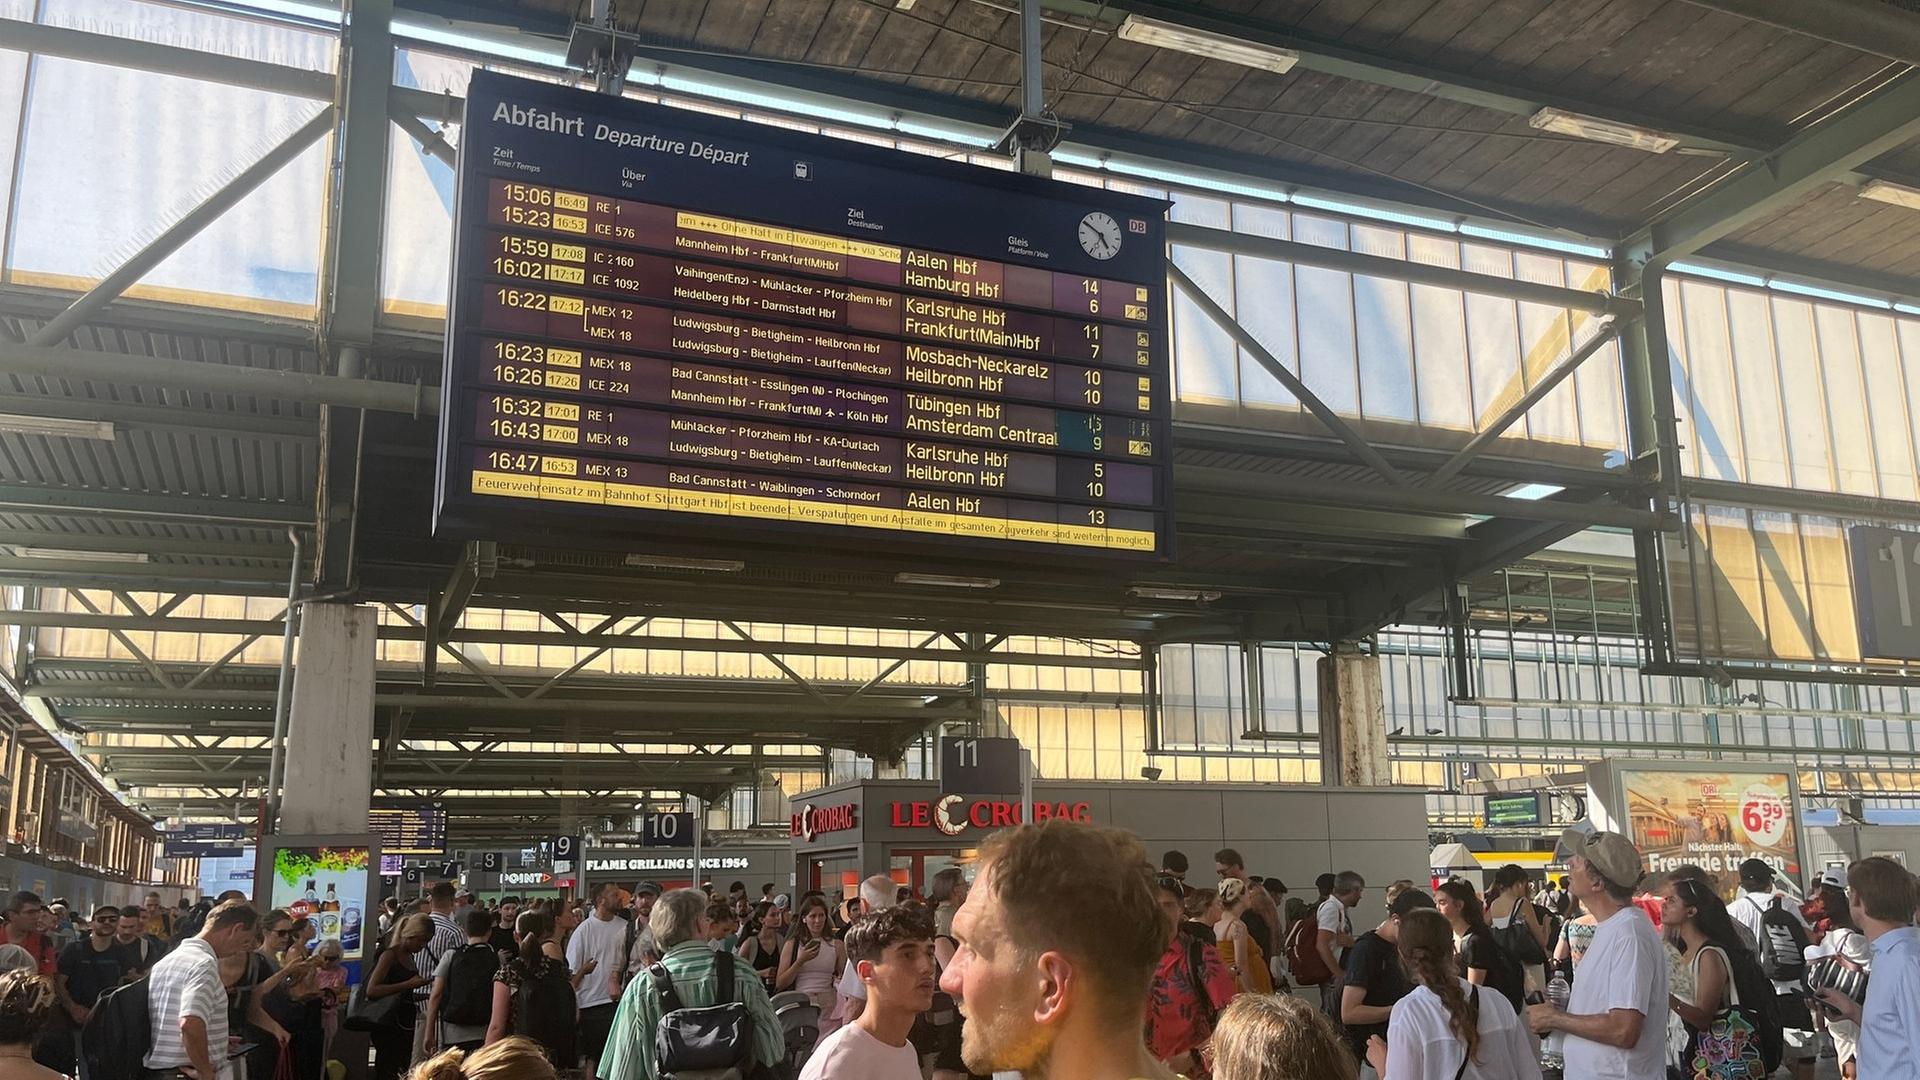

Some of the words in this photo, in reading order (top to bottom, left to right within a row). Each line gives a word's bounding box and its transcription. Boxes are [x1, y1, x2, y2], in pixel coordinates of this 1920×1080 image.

[493, 102, 584, 137] Abfahrt
[594, 124, 685, 155] Departure
[689, 141, 749, 167] Départ
[493, 146, 514, 159] Zeit
[621, 167, 646, 182] Über
[621, 180, 633, 189] Via
[847, 208, 864, 220] Ziel
[847, 219, 884, 232] Destination
[1129, 219, 1146, 233] DB
[503, 184, 551, 206] 15:06
[557, 195, 587, 210] 16:49
[596, 202, 610, 214] RE
[614, 206, 621, 215] 1
[721, 222, 748, 235] Ohne
[751, 227, 772, 238] Halt
[774, 232, 784, 241] in
[786, 232, 838, 250] Ellwangen
[861, 247, 876, 256] via
[906, 250, 948, 271] Aalen
[953, 258, 978, 276] Hbf
[1082, 280, 1099, 295] 14
[1007, 236, 1029, 248] Gleis
[502, 206, 551, 228] 15:23
[556, 216, 585, 231] 16:53
[595, 224, 612, 236] ICE
[615, 227, 636, 239] 576
[675, 236, 729, 254] Mannheim
[731, 245, 750, 257] Hbf
[905, 270, 970, 297] Hamburg
[975, 281, 999, 299] Hbf
[1090, 300, 1099, 314] 6
[500, 236, 549, 258] 15:59
[555, 247, 584, 260] 17:08
[593, 252, 605, 264] IC
[607, 254, 635, 268] 2160
[675, 265, 750, 286] Vaihingen(Enz)
[823, 288, 874, 305] Pforzheim
[876, 296, 893, 307] Hbf
[906, 298, 977, 322] Karlsruhe
[982, 309, 1006, 327] Hbf
[1083, 324, 1099, 340] 11
[493, 258, 542, 280] 16:02
[554, 268, 583, 282] 17:17
[592, 274, 610, 286] ICE
[613, 278, 640, 291] 1092
[673, 286, 729, 306] Heidelberg
[731, 295, 750, 307] Hbf
[761, 300, 816, 317] Darmstadt
[818, 308, 837, 320] Hbf
[905, 318, 1041, 351] Frankfurt(Main)Hbf
[1091, 344, 1100, 359] 7
[497, 289, 546, 311] 16:22
[552, 299, 582, 313] 17:12
[591, 305, 616, 318] MEX
[620, 309, 633, 320] 12
[673, 316, 740, 338] Ludwigsburg
[751, 327, 804, 344] Bietigheim
[815, 336, 861, 352] Heilbronn
[863, 343, 881, 354] Hbf
[906, 345, 1049, 379] Mosbach-Neckarelz
[1084, 370, 1101, 386] 10
[590, 326, 615, 339] MEX
[619, 331, 633, 342] 18
[672, 337, 740, 358] Ludwigsburg
[750, 348, 804, 364] Bietigheim
[814, 356, 892, 376] Lauffen(Neckar)
[905, 366, 974, 389] Heilbronn
[979, 375, 1003, 392] Hbf
[1084, 389, 1101, 405] 10
[495, 342, 544, 363] 16:23
[550, 352, 579, 366] 17:21
[589, 357, 614, 370] MEX
[618, 361, 632, 372] 18
[672, 367, 692, 379] Bad
[695, 370, 749, 387] Cannstatt
[760, 378, 809, 396] Esslingen
[812, 385, 825, 396] (N)
[835, 388, 889, 405] Plochingen
[906, 394, 971, 418] Tübingen
[976, 402, 1001, 420] Hbf
[493, 364, 543, 386] 16:26
[548, 374, 578, 387] 17:26
[588, 379, 606, 391] ICE
[609, 382, 630, 394] 224
[671, 389, 725, 406] Mannheim
[728, 396, 747, 408] Hbf
[758, 399, 822, 417] Frankfurt(M)
[847, 410, 869, 422] Köln
[871, 413, 889, 424] Hbf
[905, 414, 994, 439] Amsterdam
[998, 425, 1059, 446] Centraal
[1093, 436, 1102, 451] 9
[492, 396, 542, 418] 16:32
[549, 405, 577, 419] 17:01
[587, 410, 602, 422] RE
[607, 412, 613, 423] 1
[670, 419, 727, 435] Mühlacker
[738, 427, 792, 442] Pforzheim
[794, 433, 812, 444] Hbf
[823, 436, 880, 452] KA-Durlach
[906, 443, 979, 467] Karlsruhe
[984, 452, 1009, 470] Hbf
[1094, 463, 1104, 478] 5
[490, 419, 541, 440] 16:43
[546, 428, 576, 441] 17:00
[586, 432, 612, 445] MEX
[615, 435, 629, 447] 18
[670, 441, 738, 460] Ludwigsburg
[749, 448, 803, 464] Bietigheim
[814, 455, 892, 474] Lauffen(Neckar)
[906, 463, 976, 486] Heilbronn
[980, 471, 1005, 488] Hbf
[1086, 482, 1104, 498] 10
[488, 451, 539, 473] 16:47
[545, 460, 575, 473] 16:53
[585, 463, 611, 476] MEX
[615, 467, 628, 479] 13
[669, 472, 690, 485] Bad
[692, 474, 747, 489] Cannstatt
[758, 481, 815, 497] Waiblingen
[826, 487, 881, 502] Schorndorf
[907, 492, 950, 511] Aalen
[955, 497, 981, 515] Hbf
[1088, 509, 1105, 525] 13
[478, 476, 583, 497] Feuerwehreinsatz
[587, 488, 601, 498] im
[605, 488, 650, 502] Bahnhof
[655, 493, 707, 509] Stuttgart
[710, 498, 729, 508] Hbf
[732, 501, 746, 511] ist
[871, 513, 889, 523] und
[935, 519, 947, 528] im
[950, 521, 996, 533] gesamten
[998, 524, 1049, 538] Zugverkehr
[1052, 530, 1071, 540] sind
[1073, 532, 1114, 543] weiterhin
[1878, 535, 1920, 627] 1
[953, 739, 979, 768] 11
[648, 813, 678, 839] 10
[790, 813, 802, 837] LE
[812, 803, 854, 834] CROBAG
[891, 801, 930, 828] LE
[969, 800, 1092, 828] CROBAG
[1742, 801, 1762, 832] 6
[1763, 803, 1783, 820] 99
[557, 836, 571, 856] 9
[1688, 842, 1723, 852] Nächster
[407, 869, 415, 880] 6
[442, 862, 452, 875] 7
[484, 853, 495, 868] 8
[585, 859, 628, 871] FLAME
[628, 858, 685, 870] GRILLING
[686, 858, 721, 869] SNCE
[721, 857, 749, 869] 1954
[1648, 852, 1722, 873] Freunde
[385, 875, 393, 885] 5
[499, 872, 543, 884] POINT
[290, 905, 309, 914] NEU
[1765, 923, 1803, 965] NIKE
